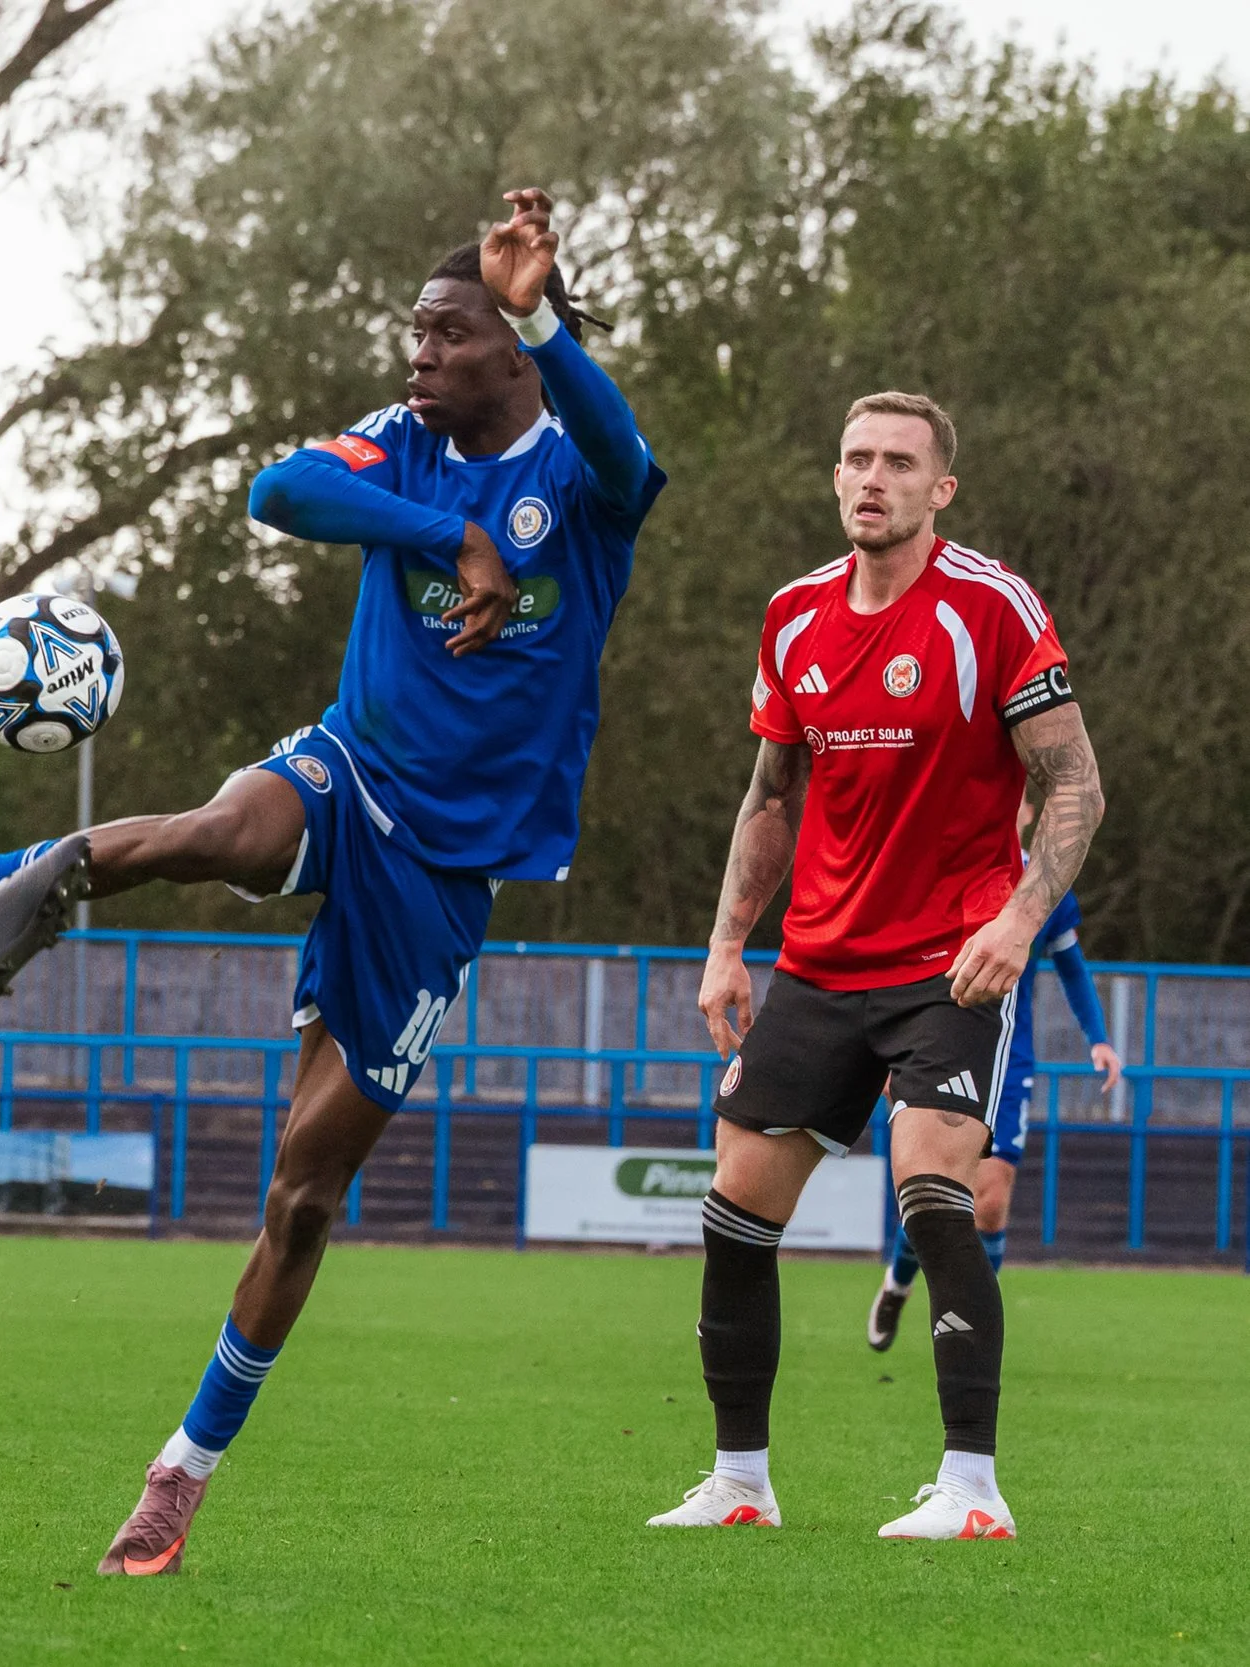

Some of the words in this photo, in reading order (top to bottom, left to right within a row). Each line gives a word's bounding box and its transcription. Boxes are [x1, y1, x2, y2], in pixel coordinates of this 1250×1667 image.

[421, 581, 535, 614] Pinle
[500, 622, 538, 639] pplies
[47, 656, 94, 693] Mitre
[1050, 665, 1072, 695] C
[827, 728, 875, 743] PROJECT
[878, 728, 913, 741] SOLAR
[392, 988, 446, 1065] 10
